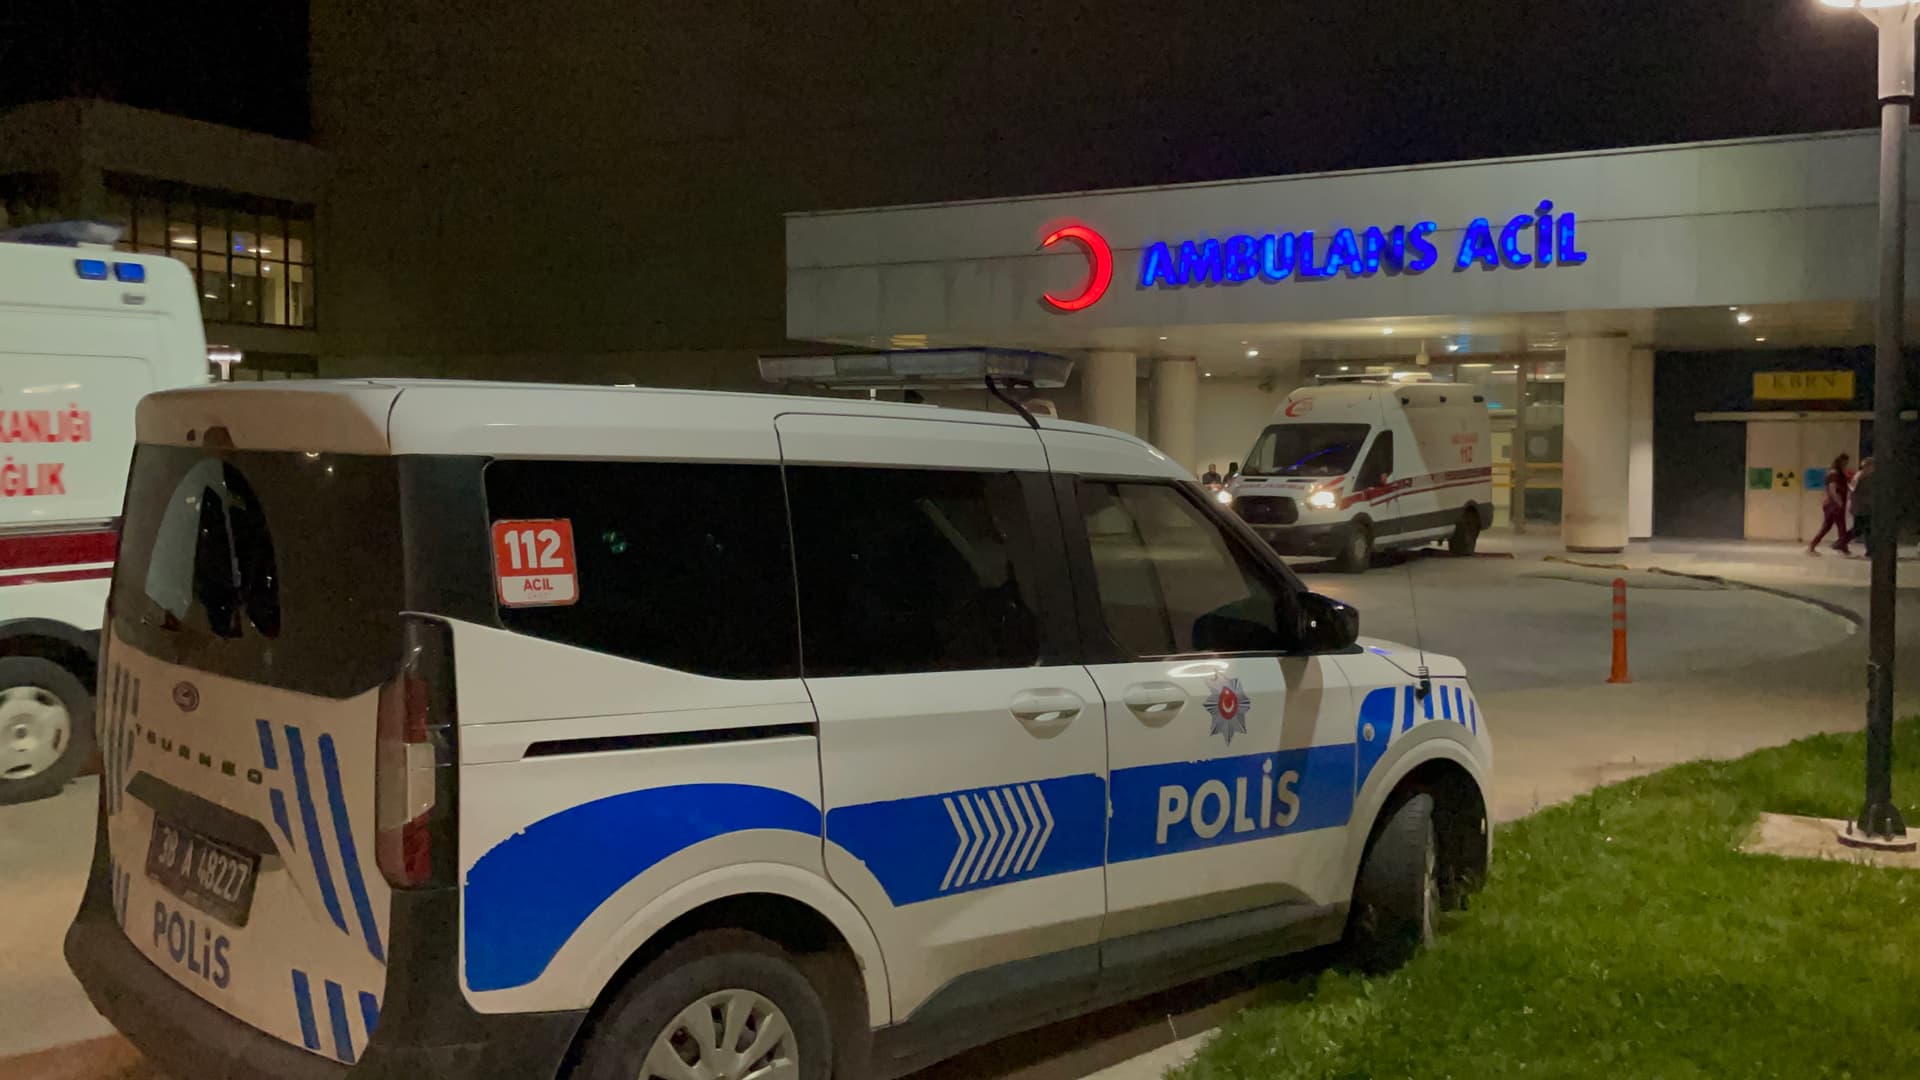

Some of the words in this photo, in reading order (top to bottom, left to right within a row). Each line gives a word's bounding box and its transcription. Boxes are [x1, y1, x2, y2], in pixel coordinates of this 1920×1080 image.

[1140, 220, 1438, 288] AMBULANS
[1457, 199, 1587, 267] ACİL
[504, 529, 564, 570] 112
[135, 723, 263, 785] TOURNEO
[1156, 758, 1300, 845] POLİS
[158, 826, 179, 868] 38
[181, 839, 194, 879] A
[153, 900, 232, 990] POLİS
